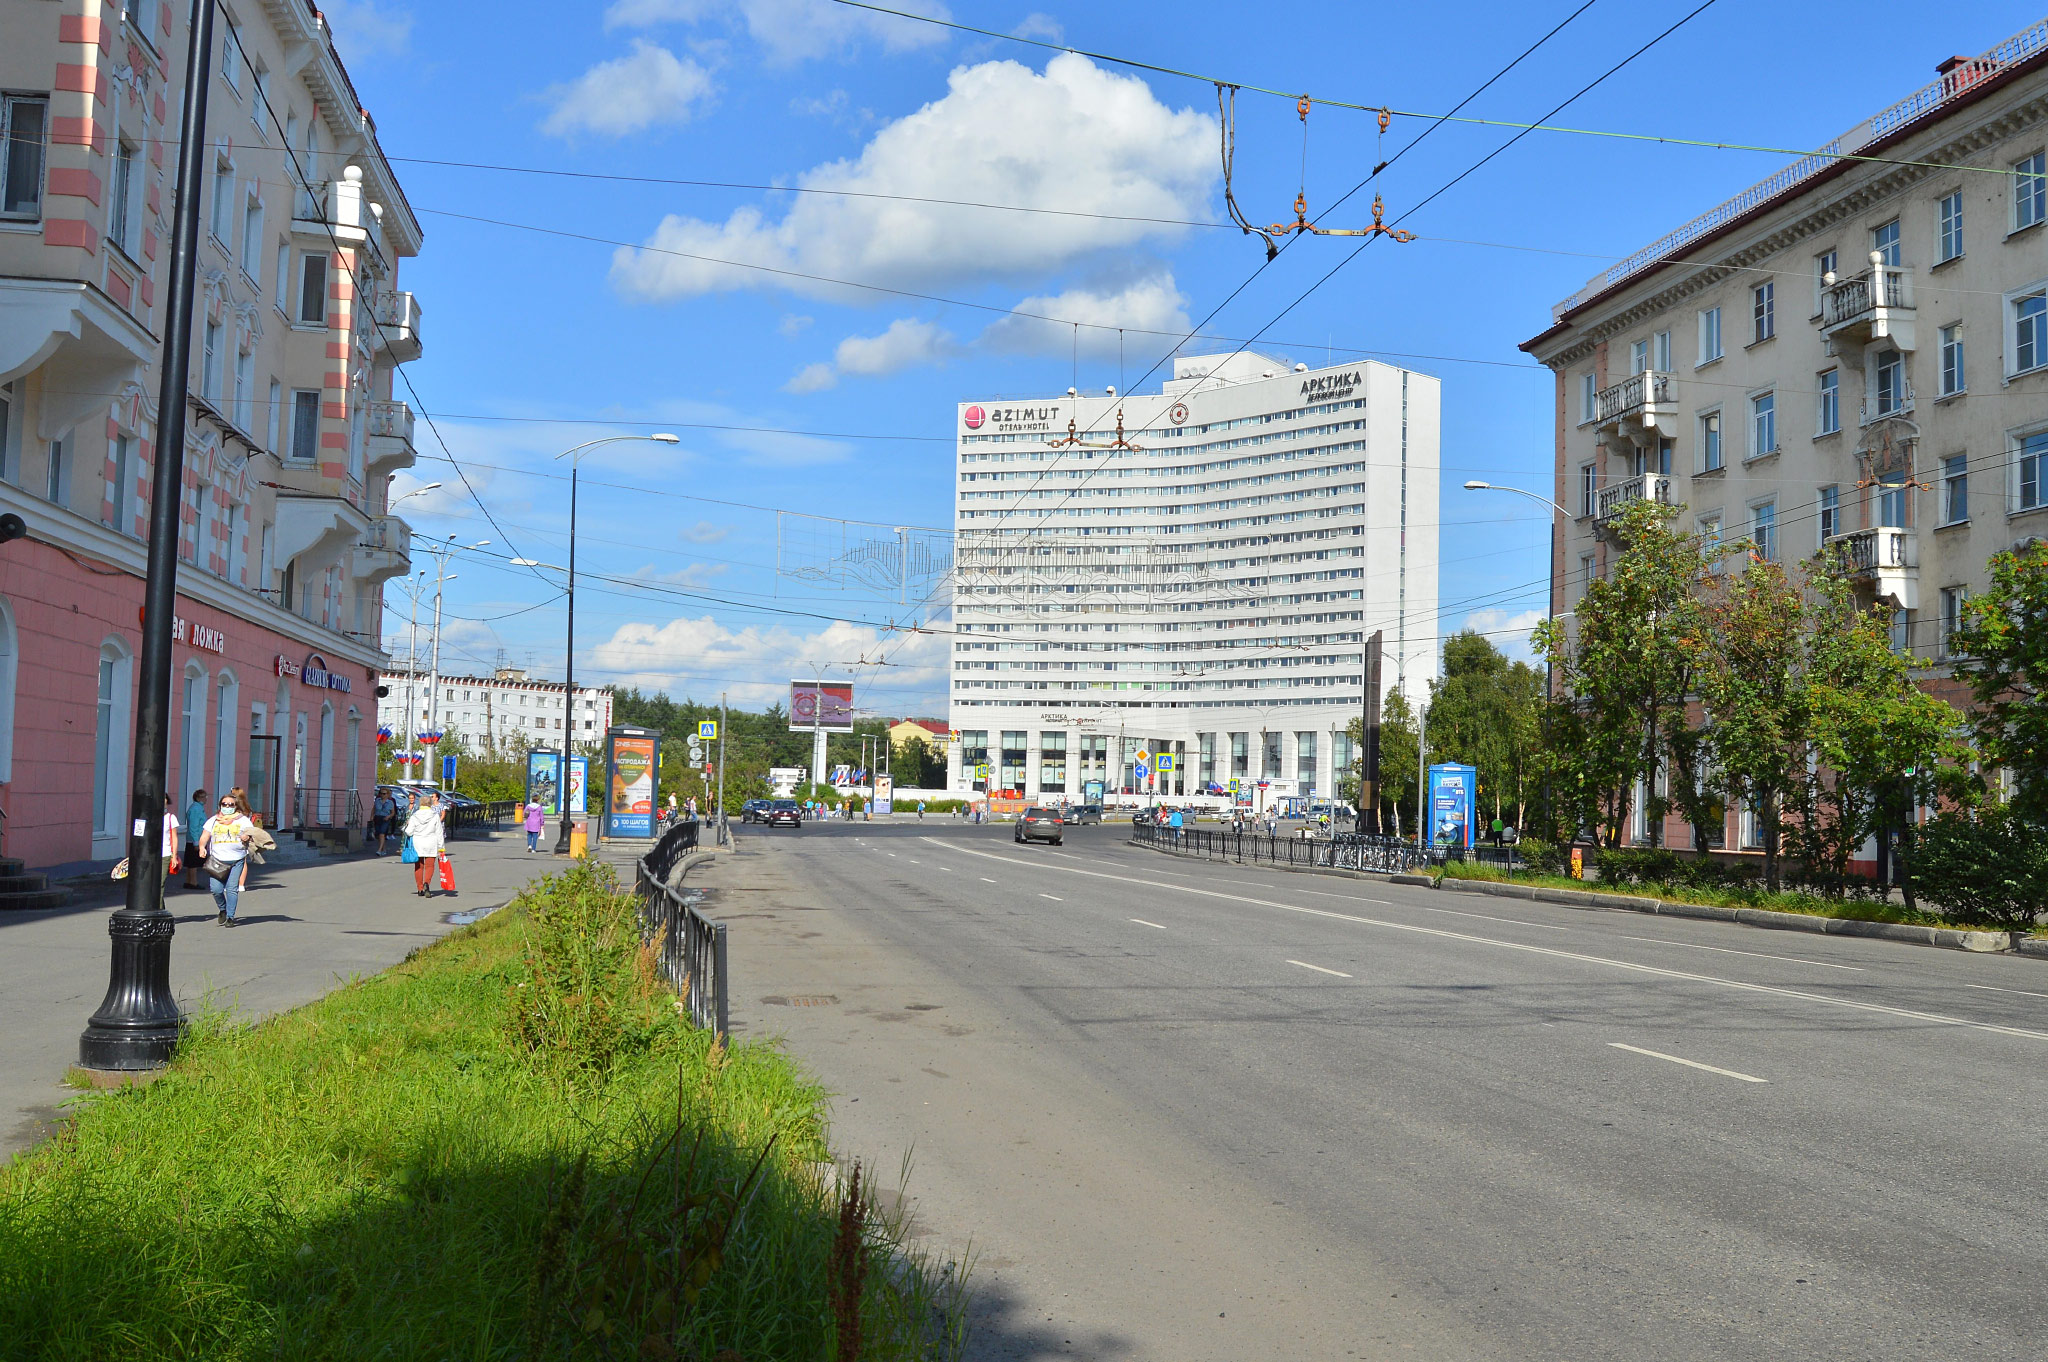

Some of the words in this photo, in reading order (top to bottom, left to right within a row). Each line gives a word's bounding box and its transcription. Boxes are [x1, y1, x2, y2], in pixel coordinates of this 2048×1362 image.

[1300, 371, 1362, 396] АРКТИКА
[1335, 387, 1354, 399] ЦЕНТР
[1028, 422, 1050, 431] HOTEL
